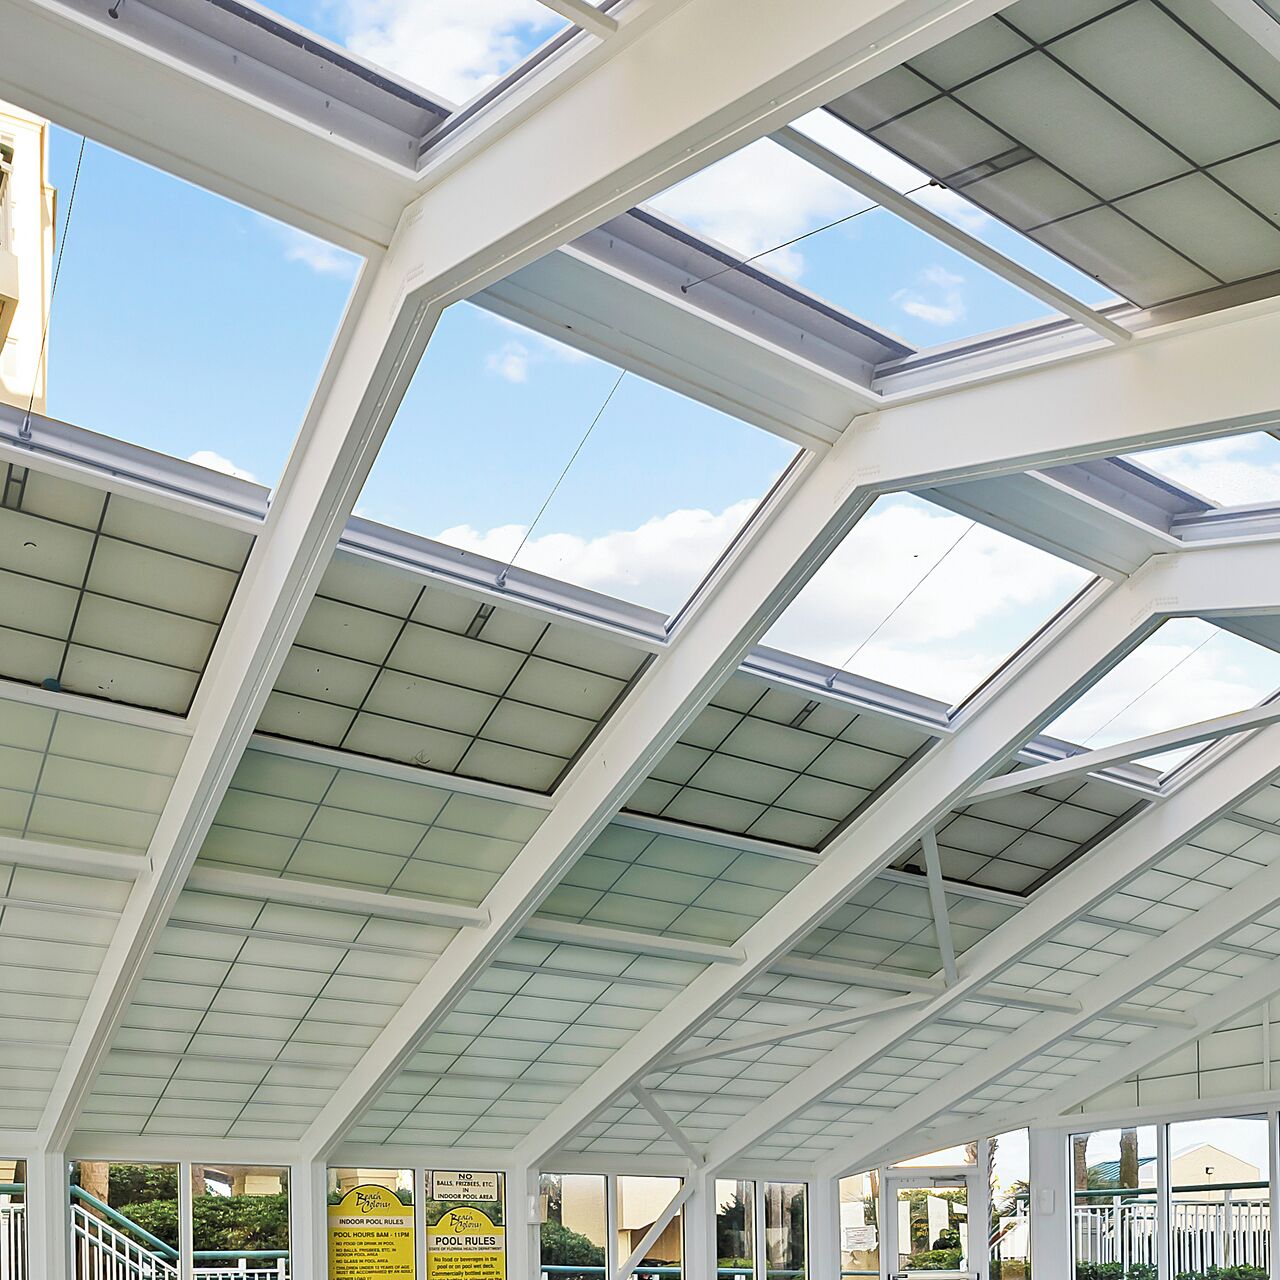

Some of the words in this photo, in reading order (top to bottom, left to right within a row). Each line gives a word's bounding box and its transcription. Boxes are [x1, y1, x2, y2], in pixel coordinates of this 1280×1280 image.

[356, 1191, 381, 1206] Beach
[361, 1200, 391, 1213] Colony
[450, 1212, 473, 1226] Beach
[436, 1237, 462, 1245] POOL
[465, 1237, 496, 1245] RULES
